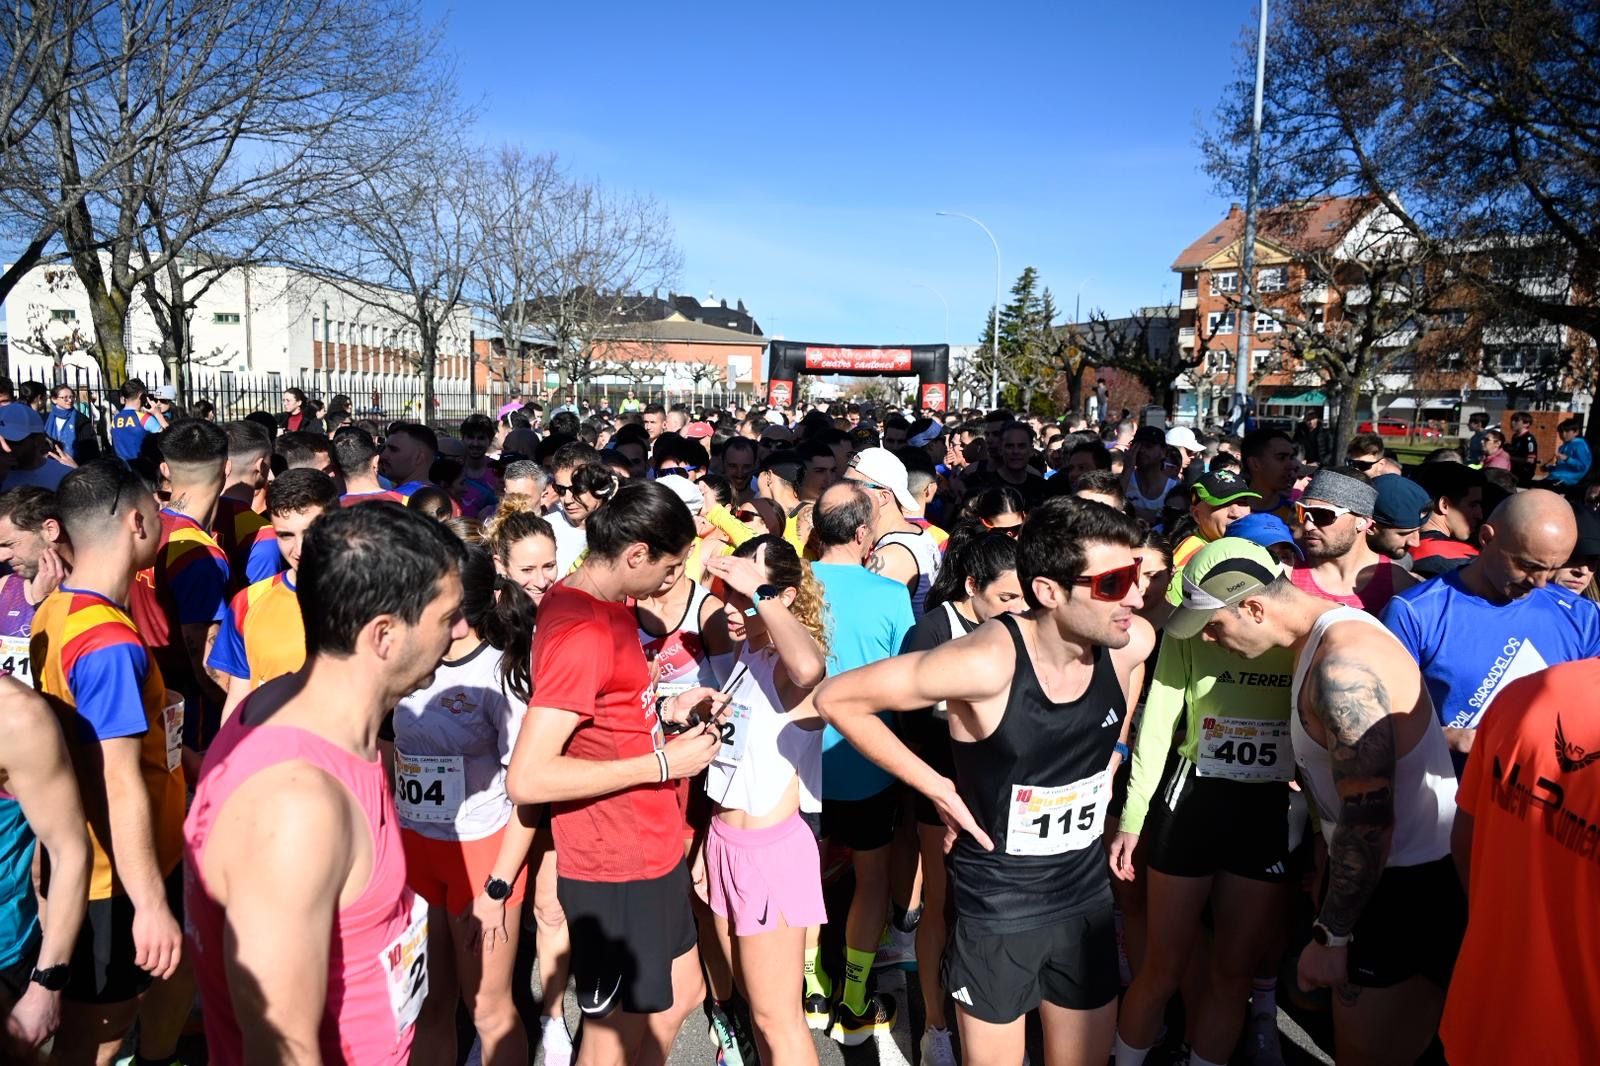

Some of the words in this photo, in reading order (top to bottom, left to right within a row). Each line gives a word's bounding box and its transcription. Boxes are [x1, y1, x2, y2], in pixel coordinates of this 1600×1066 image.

[660, 662, 679, 680] ER
[1448, 711, 1474, 729] RAIL
[1468, 637, 1521, 708] SARGADELOS
[1214, 740, 1277, 766] 405
[399, 775, 445, 806] 304
[1016, 788, 1033, 803] 10
[1032, 802, 1097, 839] 115
[1530, 776, 1600, 866] Runner
